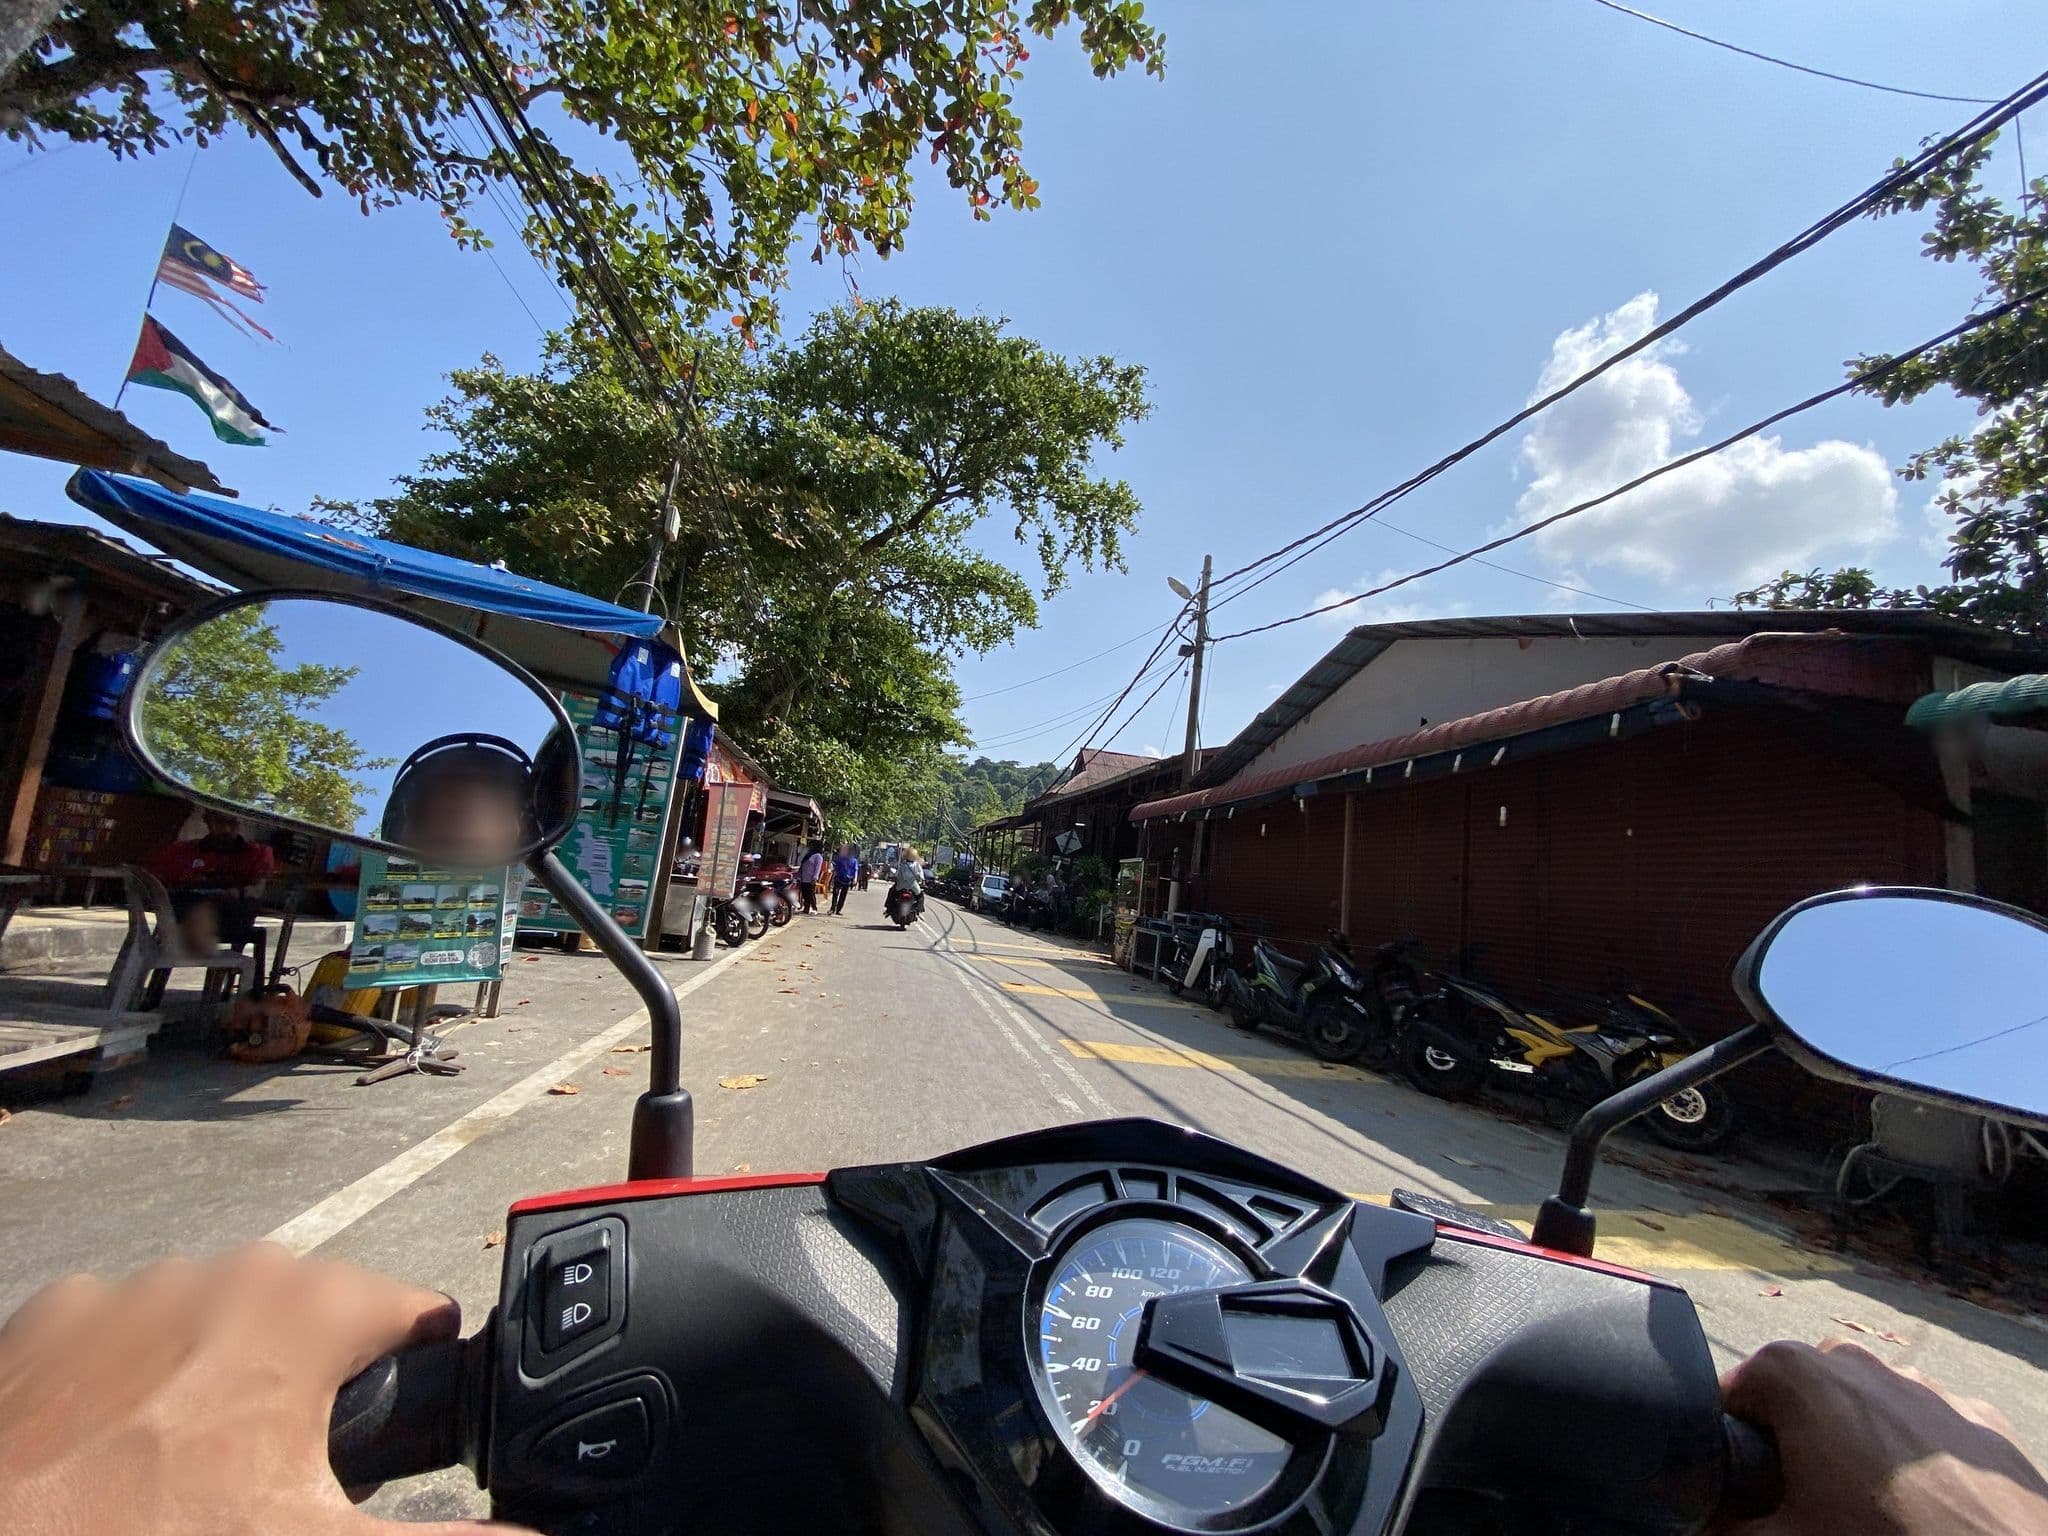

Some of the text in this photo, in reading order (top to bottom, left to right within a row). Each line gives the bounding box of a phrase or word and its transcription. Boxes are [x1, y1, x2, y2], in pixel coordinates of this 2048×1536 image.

[1112, 1267, 1143, 1280] 100
[1150, 1267, 1181, 1280] 120
[1085, 1285, 1113, 1299] 80
[1071, 1316, 1101, 1330] 60
[1071, 1357, 1102, 1372] 40
[1123, 1440, 1141, 1456] 0
